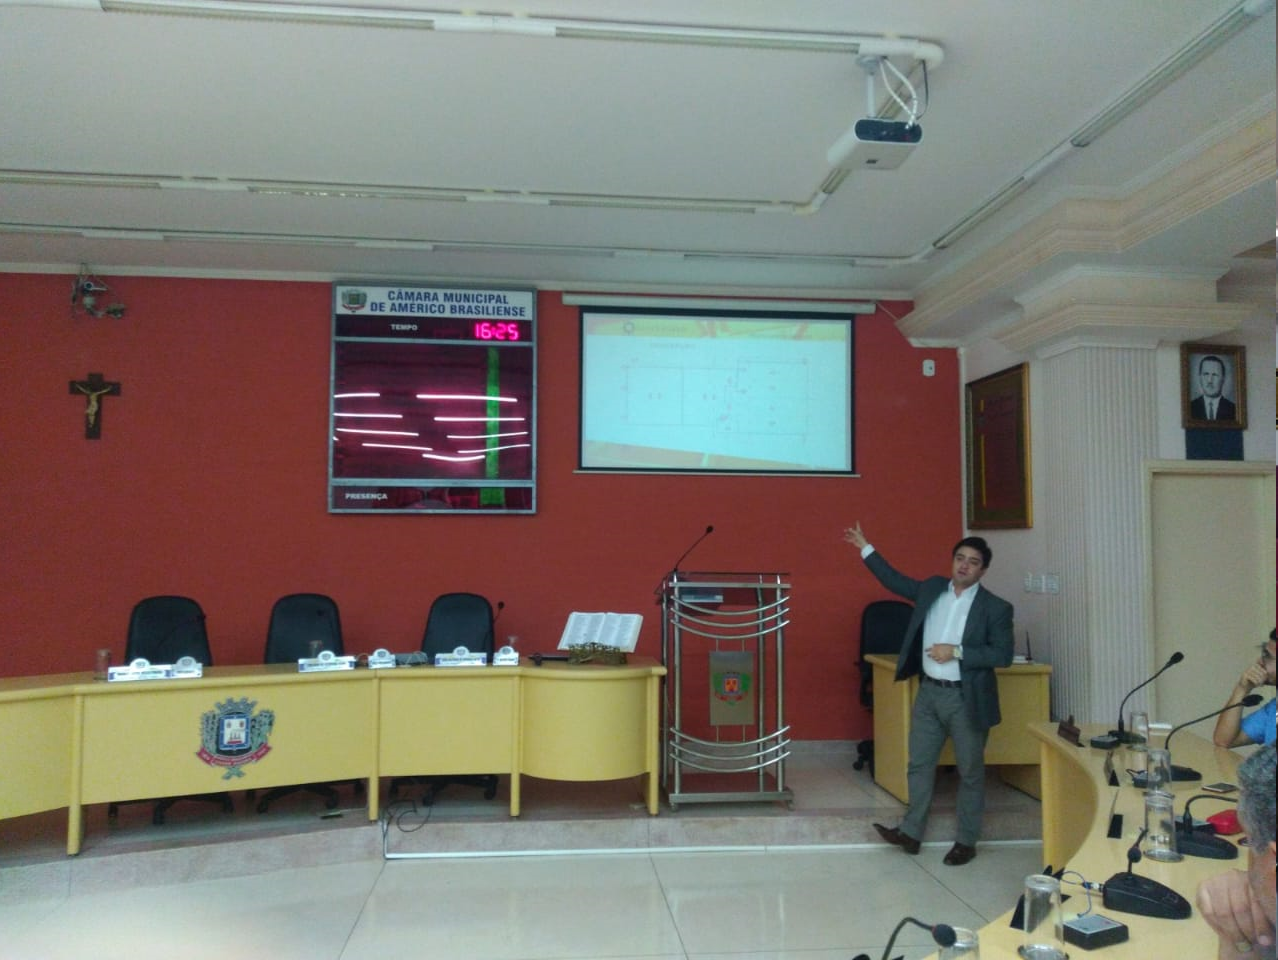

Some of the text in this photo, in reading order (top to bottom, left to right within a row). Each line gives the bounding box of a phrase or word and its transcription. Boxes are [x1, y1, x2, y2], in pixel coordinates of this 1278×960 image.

[387, 288, 509, 305] CÂMARA MUNICIPAL
[370, 301, 386, 312] DE
[449, 304, 526, 317] BRASILIENSE
[390, 323, 418, 331] TEMPO
[474, 321, 519, 341] 16:25
[344, 492, 388, 501] PRESENÇA
